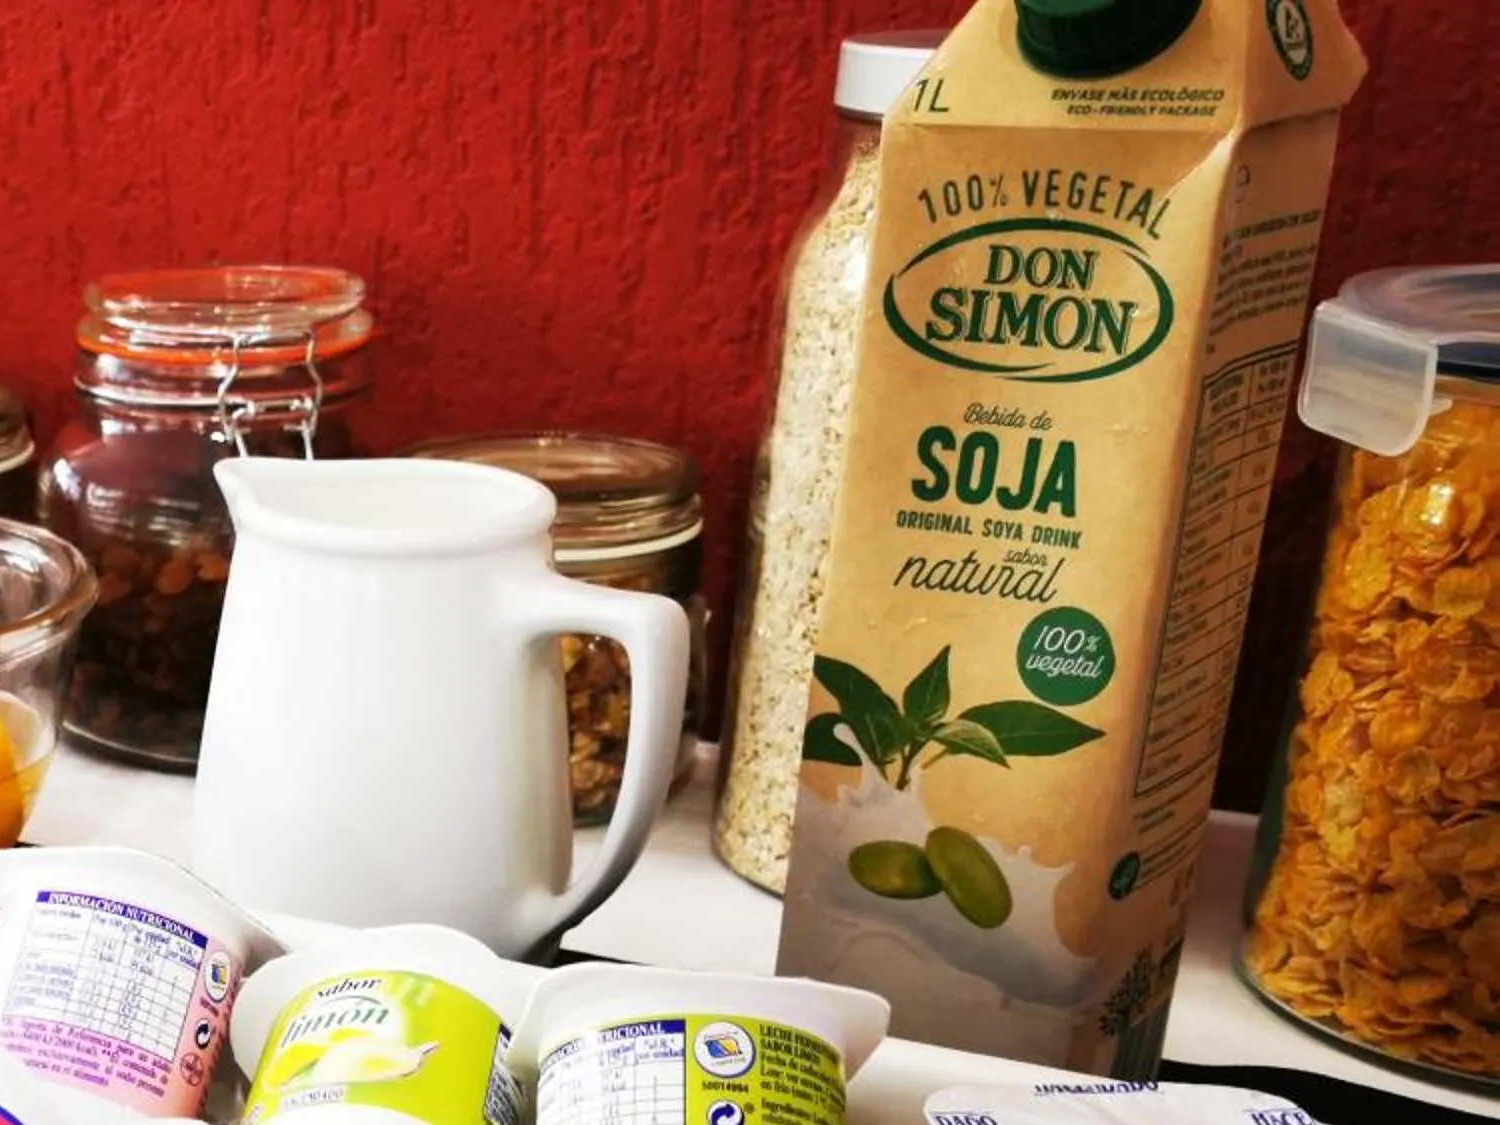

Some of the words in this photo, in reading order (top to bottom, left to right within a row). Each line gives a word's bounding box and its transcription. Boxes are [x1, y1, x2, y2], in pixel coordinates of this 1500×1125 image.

[911, 79, 950, 113] 1L
[918, 172, 1009, 224] 100%
[1021, 169, 1175, 241] VEGETAL
[985, 242, 1097, 290] DON
[924, 286, 1141, 357] SIMON
[963, 402, 1026, 430] Bebida
[1030, 409, 1053, 432] de
[910, 424, 1078, 518] SOJA
[896, 509, 974, 537] ORIGINAL
[981, 519, 1024, 543] SOYA
[1031, 524, 1082, 551] DRINK
[893, 551, 1067, 604] natural
[1002, 546, 1048, 568] sabor
[1032, 625, 1101, 656] 100%
[1025, 651, 1104, 680] vegetal
